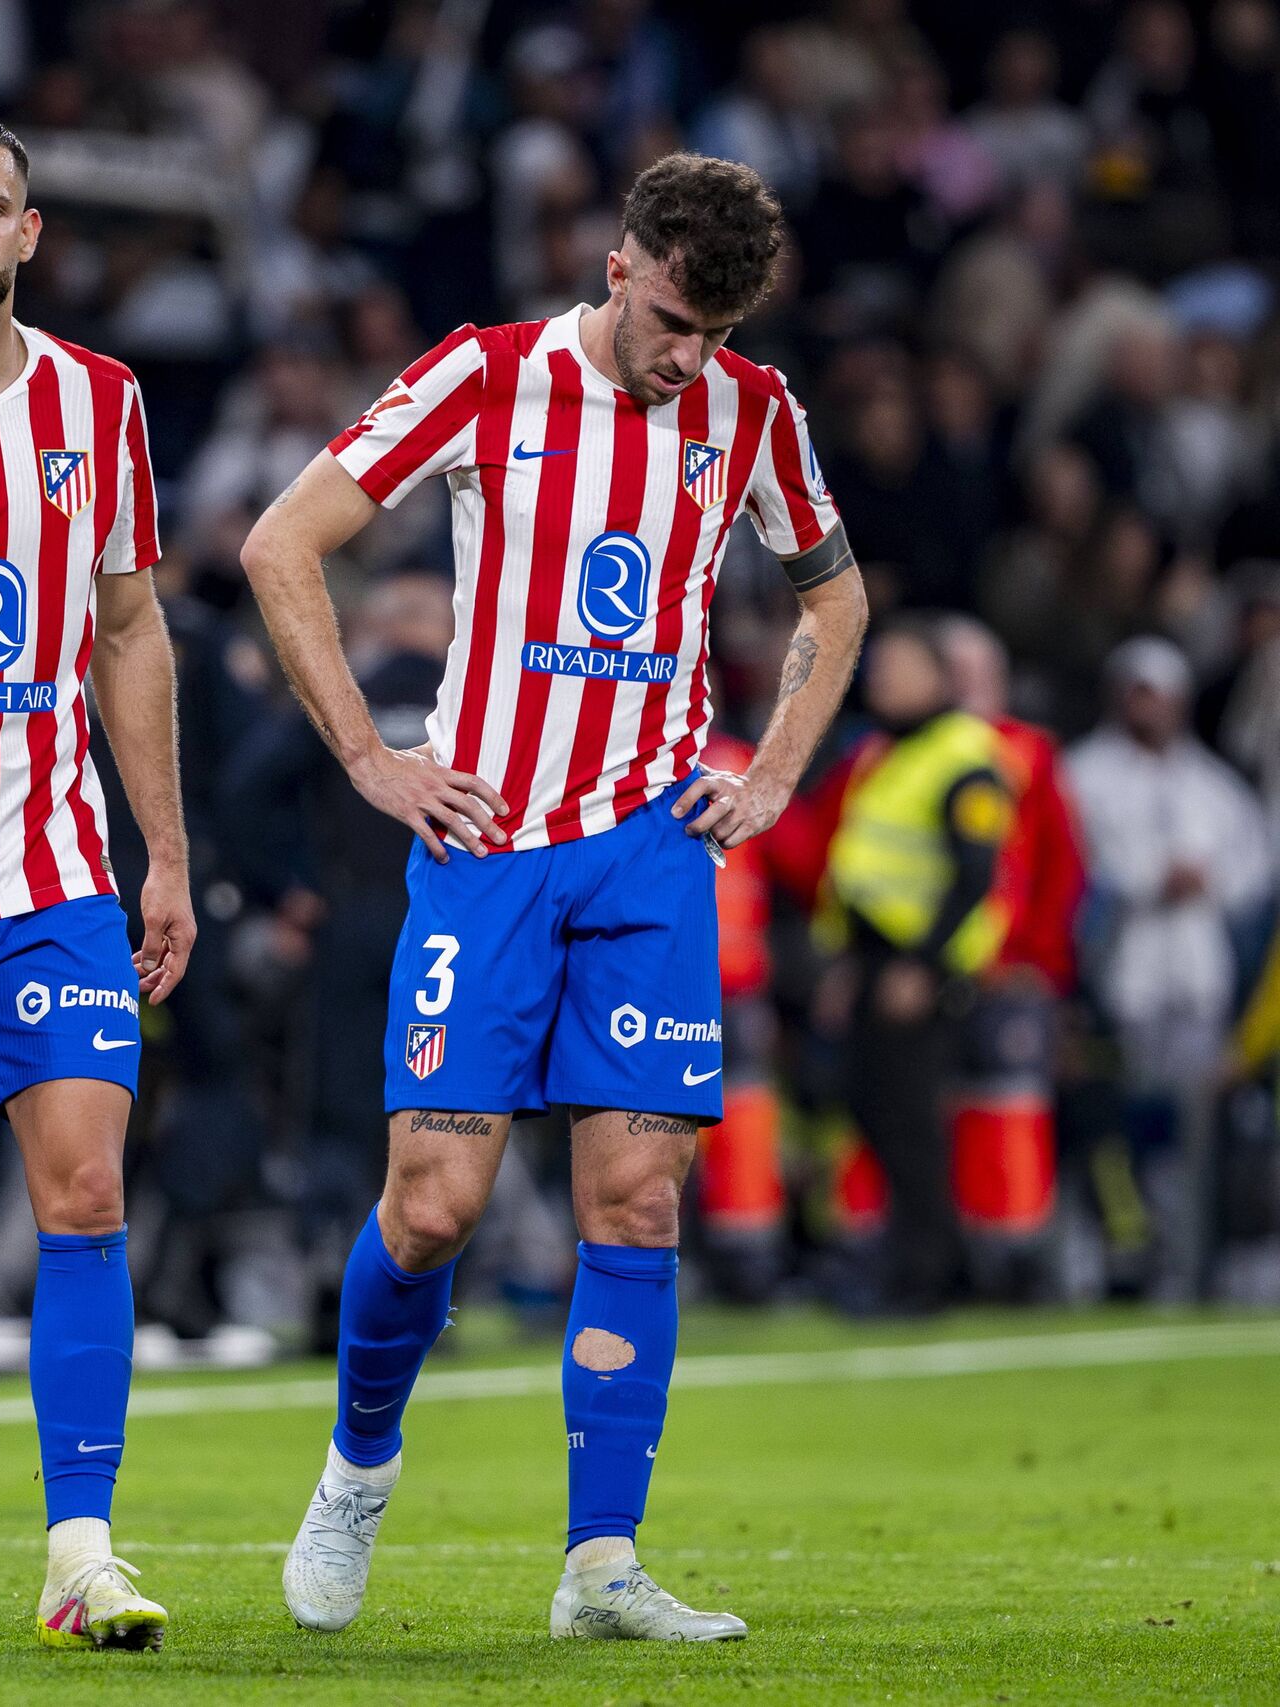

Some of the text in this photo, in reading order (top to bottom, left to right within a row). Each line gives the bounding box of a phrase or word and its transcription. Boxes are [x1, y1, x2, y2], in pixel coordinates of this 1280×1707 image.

[528, 645, 673, 680] RIYADH AIR
[19, 685, 52, 710] AIR
[415, 934, 460, 1016] 3
[411, 1110, 492, 1136] Isabella
